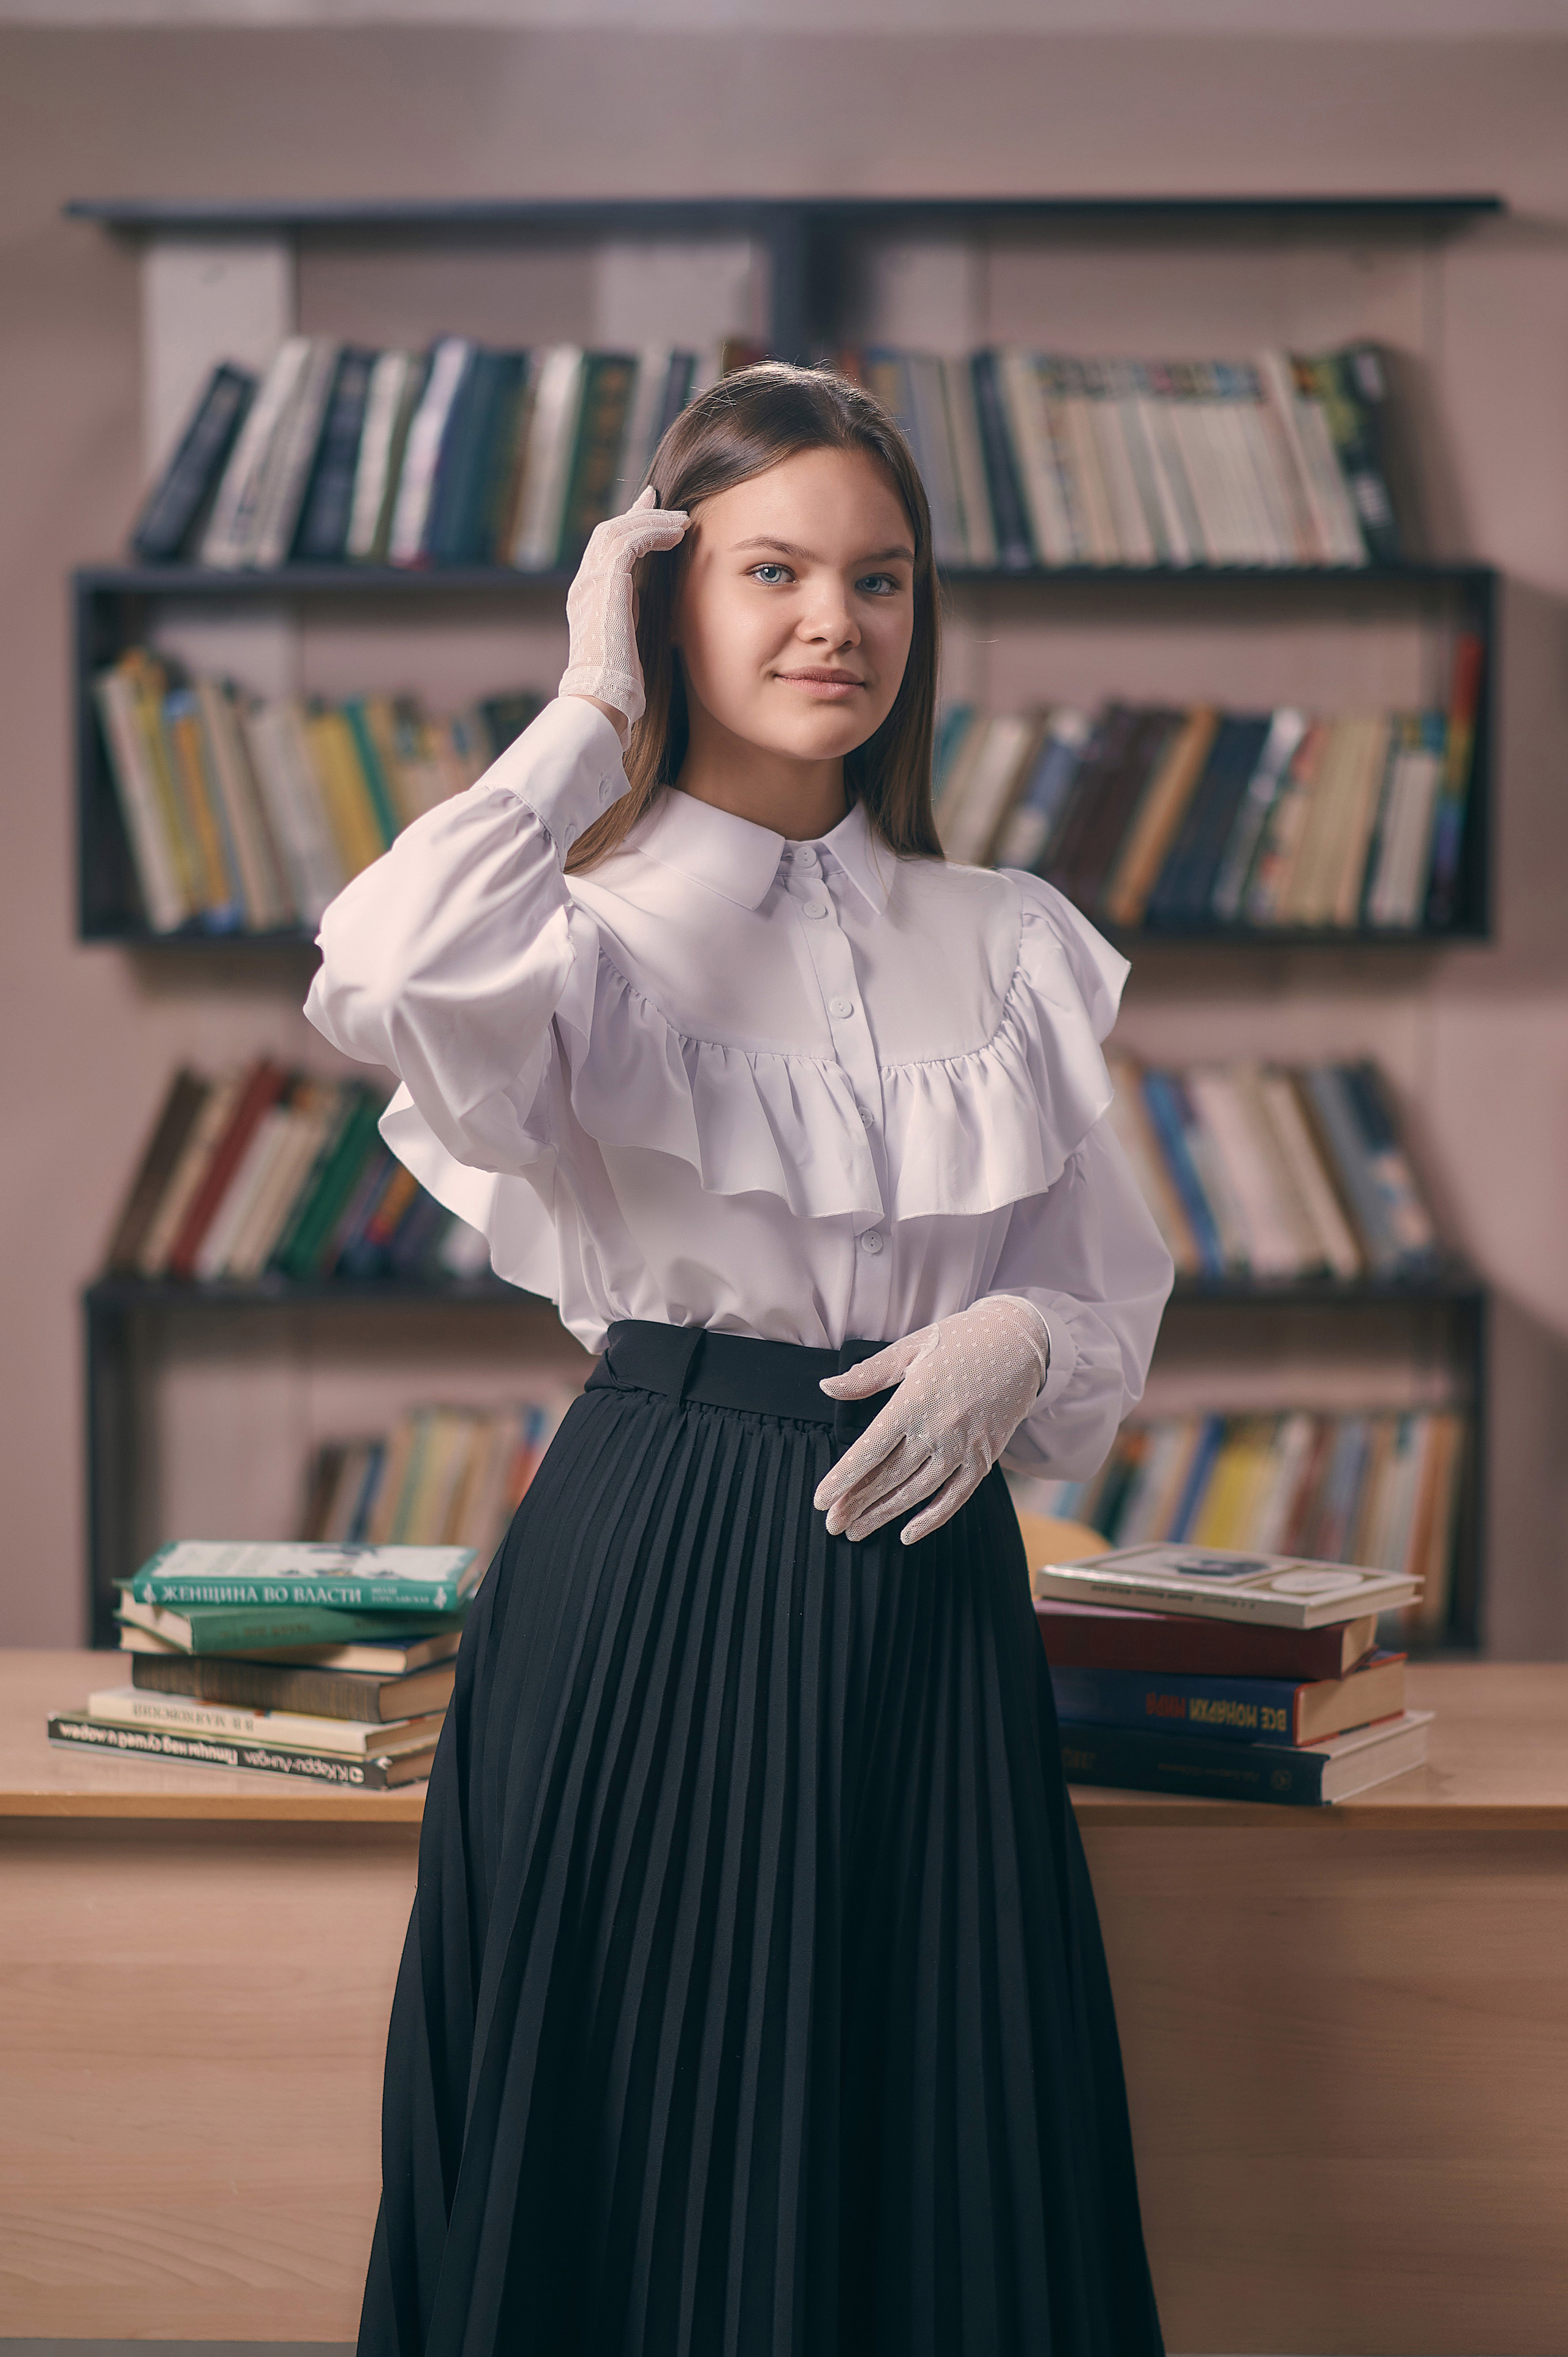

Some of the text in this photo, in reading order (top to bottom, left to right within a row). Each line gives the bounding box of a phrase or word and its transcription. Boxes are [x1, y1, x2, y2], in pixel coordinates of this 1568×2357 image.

[162, 1586, 361, 1605] ЖЕНЩИНА ВО ВЛАСТИ
[134, 1703, 227, 1728] МАЯКОВСКИЙ
[1147, 1692, 1287, 1731] ВСЕ МОНАРХИ МИРА
[59, 1723, 107, 1743] морем
[107, 1730, 116, 1745] и
[116, 1731, 160, 1752] сушей
[162, 1735, 189, 1755] над
[189, 1741, 238, 1765] Птицы
